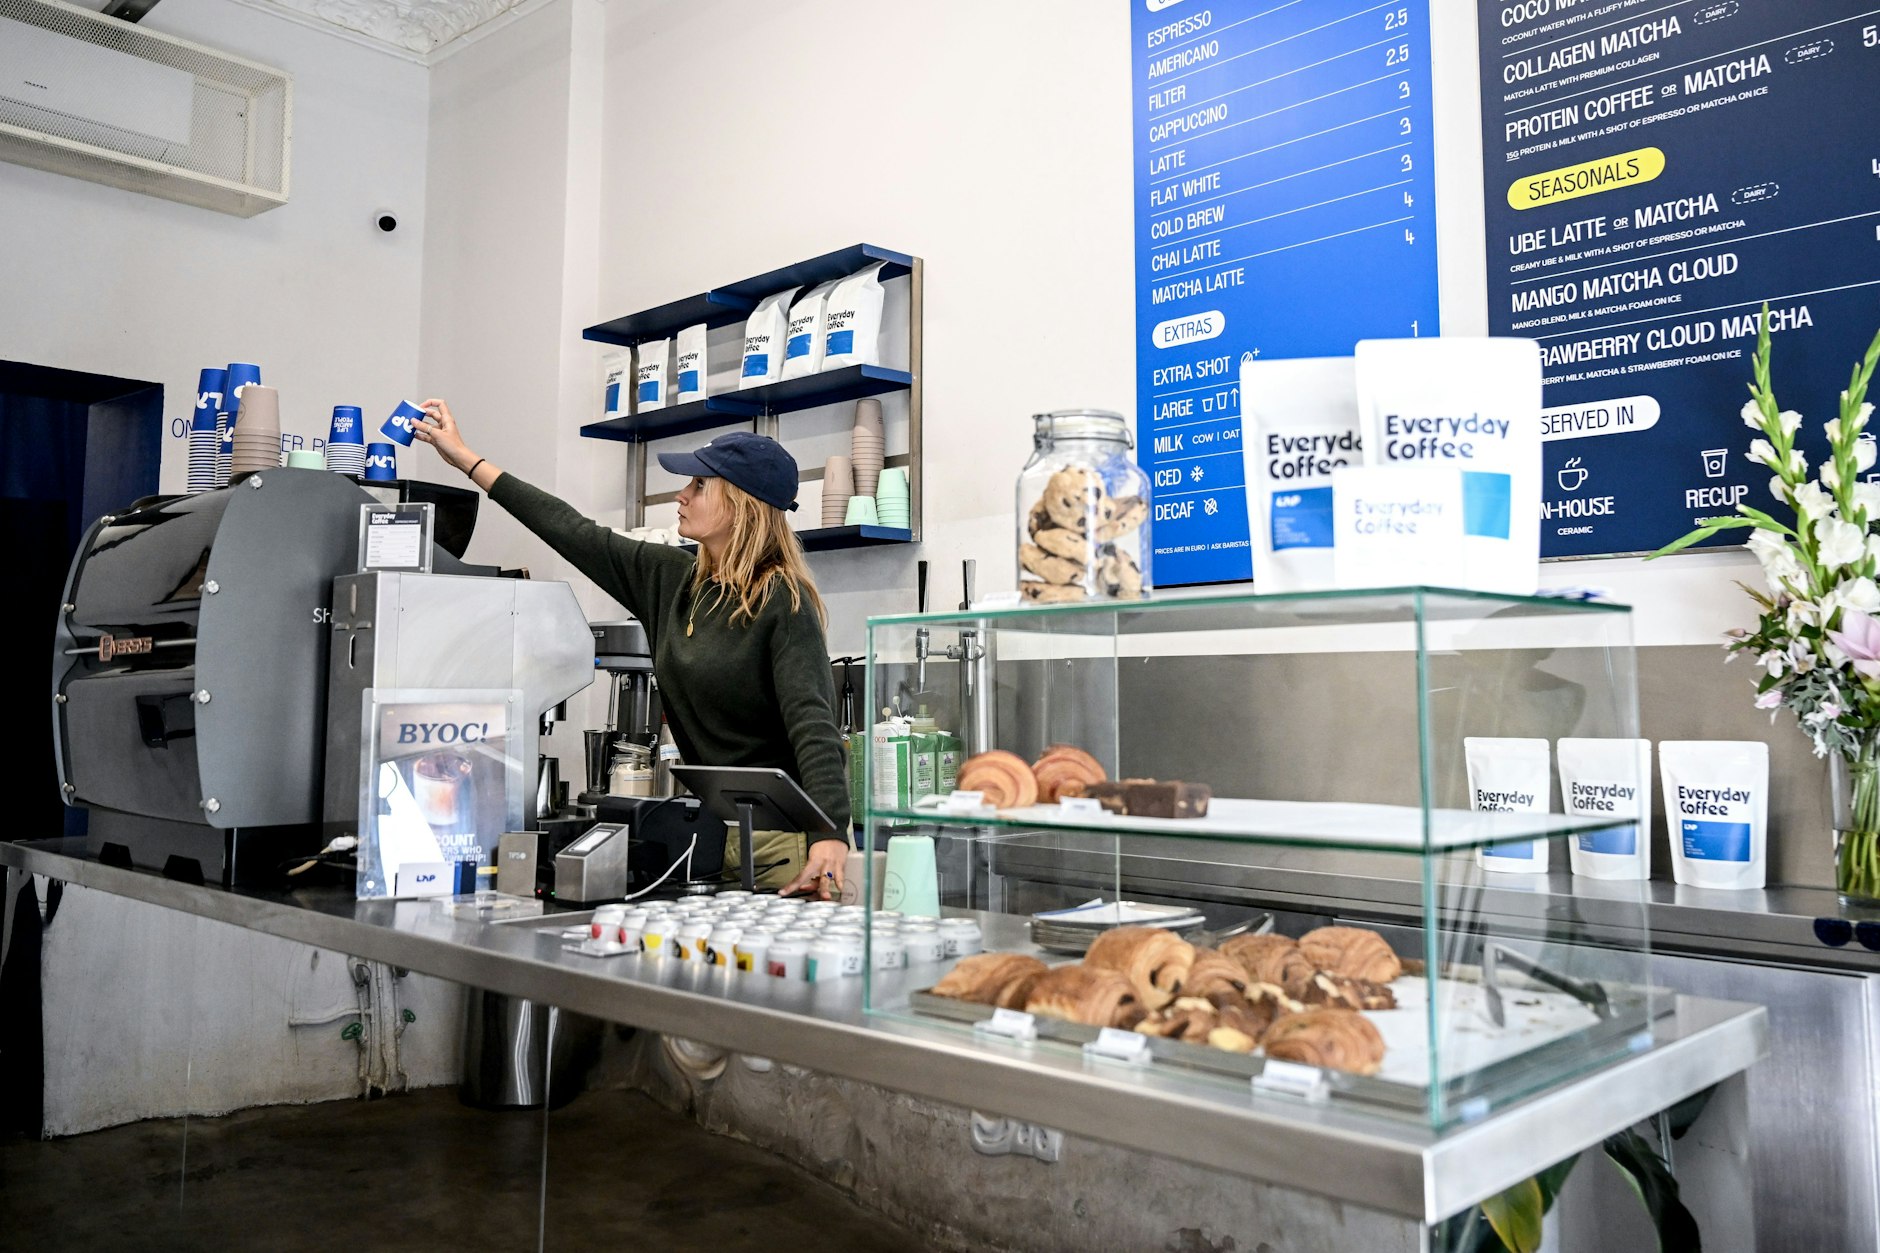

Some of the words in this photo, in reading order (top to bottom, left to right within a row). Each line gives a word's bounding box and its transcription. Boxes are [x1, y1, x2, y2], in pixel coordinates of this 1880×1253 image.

[1147, 10, 1212, 48] ESPRESSO
[1501, 0, 1550, 27] COCO
[1502, 28, 1538, 45] COCONUT
[1539, 20, 1565, 33] WATER
[1566, 13, 1587, 25] WITH
[1587, 11, 1593, 19] A
[1594, 3, 1622, 17] FLUFFY
[1148, 85, 1186, 111] FILTER
[1384, 8, 1408, 31] 2.5
[1148, 40, 1219, 79] AMERICANO
[1503, 40, 1595, 84] COLLAGEN
[1601, 15, 1682, 56] MATCHA
[1705, 7, 1727, 18] DAIRY
[1149, 103, 1228, 143] CAPPUCCINO
[1386, 44, 1409, 66] 2.5
[1504, 88, 1534, 101] MATCHA
[1535, 82, 1558, 94] LATTE
[1559, 76, 1579, 87] WITH
[1580, 65, 1615, 81] PREMIUM
[1616, 52, 1660, 70] COLLAGEN
[1506, 105, 1579, 142] PROTEIN
[1584, 85, 1654, 121] COFFEE
[1661, 84, 1677, 97] OR
[1684, 54, 1772, 95] MATCHA
[1797, 46, 1821, 57] DAIRY
[1150, 150, 1186, 176] LATTE
[1399, 81, 1410, 99] 3
[1506, 150, 1520, 161] 15G
[1520, 142, 1551, 156] PROTEIN
[1552, 140, 1558, 148] &
[1559, 136, 1576, 146] MILK
[1577, 130, 1598, 141] WITH
[1599, 128, 1605, 136] A
[1606, 123, 1628, 134] SHOT
[1629, 119, 1641, 128] OF
[1642, 107, 1686, 125] ESPRESSO
[1687, 104, 1700, 114] OR
[1701, 95, 1737, 110] MATCHA
[1738, 91, 1753, 101] ON
[1753, 86, 1769, 97] ICE
[1150, 185, 1178, 207] FLAT
[1182, 172, 1221, 197] WHITE
[1400, 117, 1411, 135] 3
[1529, 158, 1640, 201] SEASONALS
[1151, 218, 1183, 239] COLD
[1187, 204, 1225, 230] BREW
[1401, 154, 1412, 172] 3
[1152, 250, 1180, 271] CHAI
[1183, 239, 1221, 264] LATTE
[1404, 191, 1413, 208] 4
[1509, 229, 1546, 255] UBE
[1551, 216, 1607, 247] LATTE
[1613, 217, 1629, 230] OR
[1634, 193, 1719, 229] MATCHA
[1744, 188, 1766, 199] DAIRY
[1510, 260, 1541, 272] CREAMY
[1541, 257, 1557, 267] UBE
[1564, 253, 1582, 262] MILK
[1584, 248, 1604, 259] WITH
[1605, 246, 1612, 254] A
[1612, 241, 1635, 252] SHOT
[1636, 238, 1648, 247] OF
[1649, 230, 1693, 246] ESPRESSO
[1694, 227, 1708, 236] OR
[1708, 219, 1746, 233] MATCHA
[1152, 278, 1203, 305] MATCHA
[1206, 268, 1245, 291] LATTE
[1405, 229, 1415, 245] 4
[1511, 283, 1577, 312] MANGO
[1583, 267, 1663, 300] MATCHA
[1668, 252, 1738, 284] CLOUD
[789, 315, 814, 327] veryday
[1512, 319, 1541, 330] MANGO
[1541, 314, 1568, 326] BLEND,
[1568, 311, 1586, 321] MILK
[1587, 309, 1593, 317] &
[1594, 304, 1627, 315] MATCHA
[1628, 300, 1652, 310] FOAM
[1653, 297, 1667, 306] ON
[1667, 294, 1682, 303] ICE
[789, 326, 803, 336] offee
[1164, 318, 1212, 343] EXTRAS
[1539, 332, 1640, 367] RAWBERRY
[1646, 321, 1715, 351] CLOUD
[1721, 305, 1813, 340] MATCHA
[1153, 363, 1192, 386] EXTRA
[1196, 356, 1230, 378] SHOT
[1411, 320, 1419, 338] 1
[1541, 375, 1565, 385] BERRY
[1565, 373, 1585, 382] MILK,
[1586, 368, 1619, 379] MATCHA
[1627, 358, 1684, 373] STRAWBERRY
[1685, 354, 1711, 364] FOAM
[1712, 352, 1726, 361] ON
[1726, 349, 1742, 359] ICE
[1154, 399, 1193, 421] LARGE
[1386, 413, 1510, 439] Everyday
[1540, 407, 1609, 435] SERVED
[1616, 405, 1634, 425] IN
[1154, 434, 1183, 454] MILK
[1192, 433, 1214, 444] COW
[1222, 428, 1240, 440] OAT
[1267, 430, 1363, 455] Everyd
[1386, 437, 1474, 461] Coffee
[1154, 468, 1182, 487] ICED
[1155, 501, 1195, 521] DECAF
[1354, 499, 1443, 517] Everyday
[1540, 495, 1614, 520] N-HOUSE
[1686, 484, 1749, 509] RECUP
[1354, 518, 1417, 536] Coffee
[1557, 524, 1593, 536] CERAMIC
[1154, 547, 1173, 555] PRICES
[1191, 544, 1206, 552] EURO
[1211, 542, 1221, 550] ASK
[1222, 540, 1249, 549] BARISTAS
[397, 722, 488, 744] BYOC!
[1477, 789, 1534, 807] Everyday
[1572, 782, 1635, 800] Everyday
[1572, 797, 1614, 811] Coffee
[1678, 785, 1750, 804] Everyday
[1680, 801, 1729, 816] Coffee
